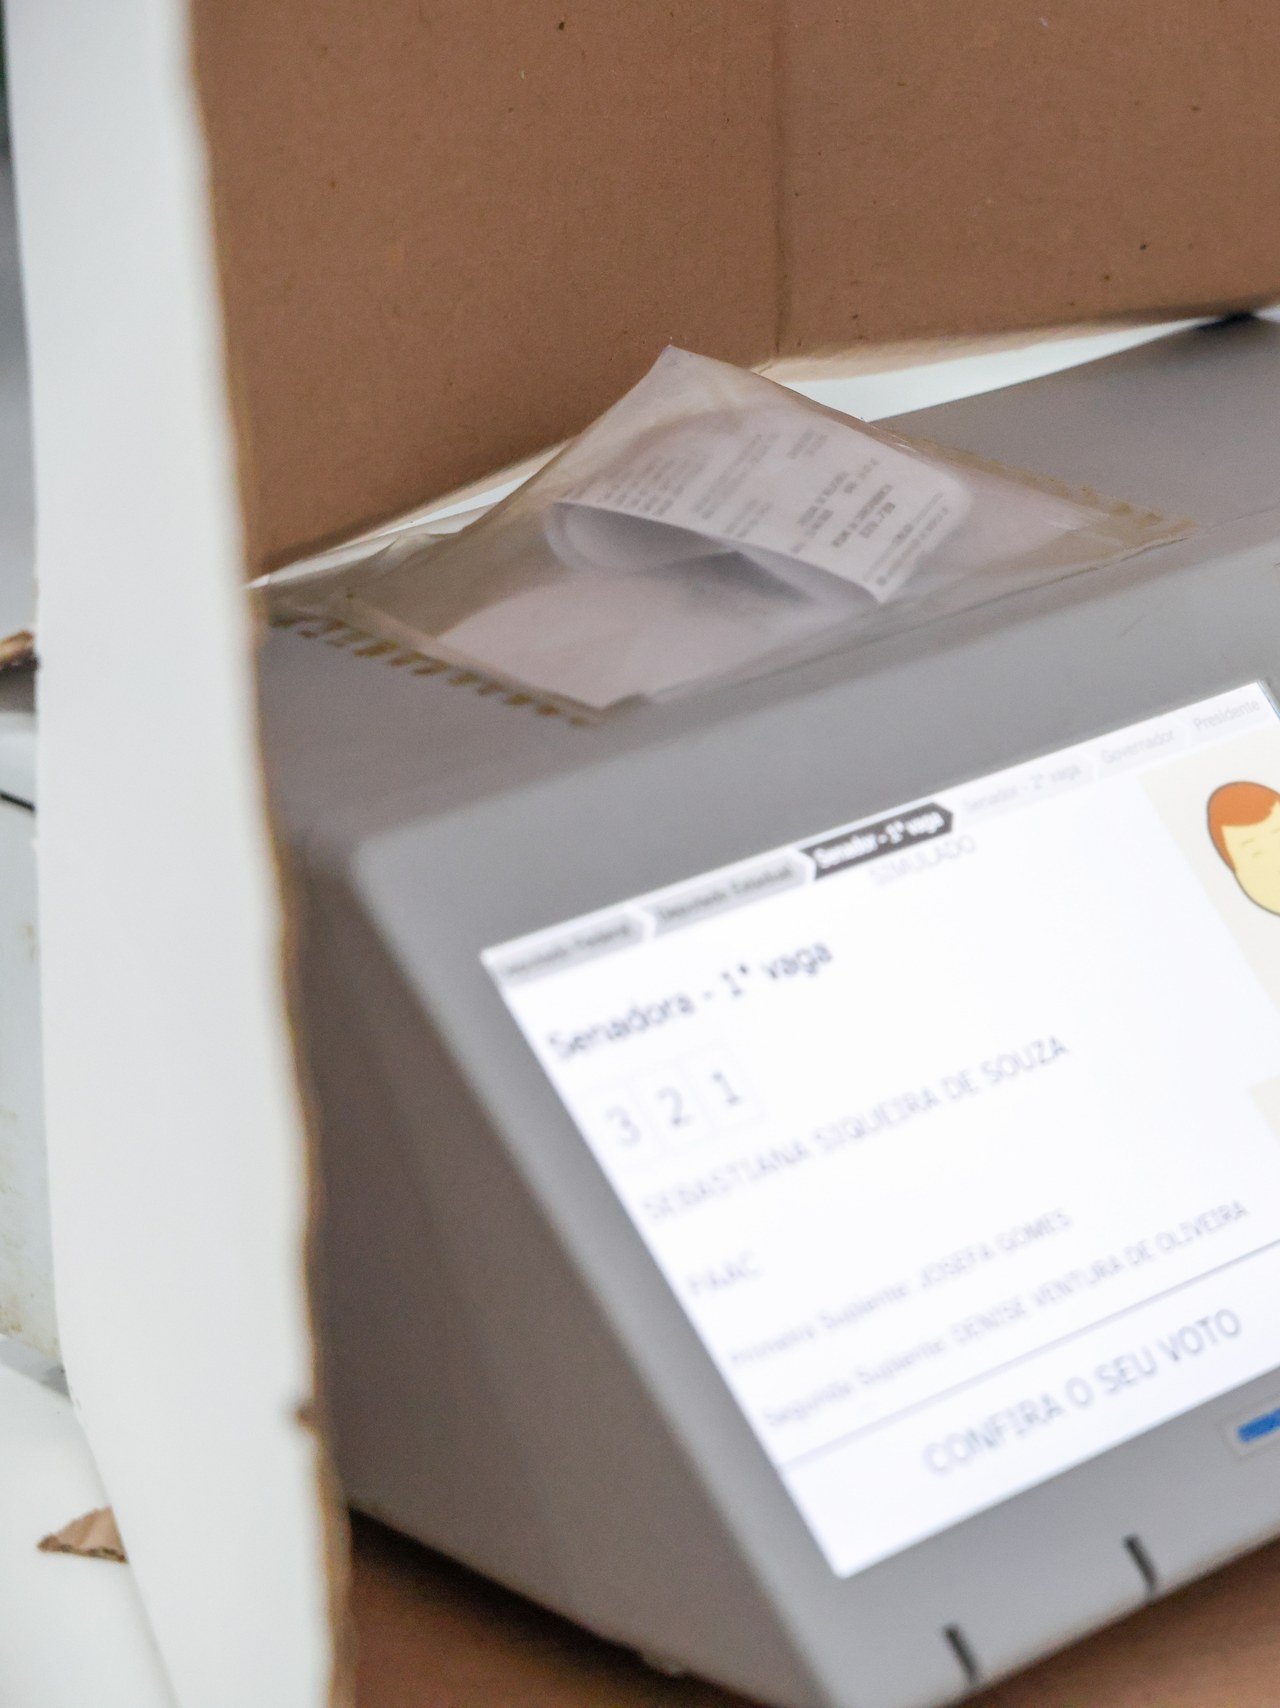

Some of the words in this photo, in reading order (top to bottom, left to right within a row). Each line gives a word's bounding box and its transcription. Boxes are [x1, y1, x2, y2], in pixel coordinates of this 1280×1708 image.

[1100, 728, 1174, 764] Governador
[1192, 698, 1260, 730] Presidente
[813, 830, 878, 871] Senador
[904, 811, 945, 840] vaga
[868, 834, 976, 888] SIMULADO
[548, 991, 695, 1059] Senadora
[766, 940, 833, 983] vaga
[608, 1105, 641, 1147] 3
[657, 1085, 694, 1128] 2
[711, 1068, 741, 1107] 1
[643, 1140, 811, 1222] SEBASTIANA
[812, 1088, 942, 1152] SIQUEIRA
[940, 1070, 980, 1102] DE
[980, 1035, 1069, 1085] SOUZA
[919, 1244, 996, 1289] JOSEFA
[994, 1209, 1072, 1256] GOMES
[953, 1297, 1027, 1346] DENISE
[1033, 1257, 1123, 1309] VENTURA
[1124, 1241, 1155, 1268] DE
[1155, 1202, 1249, 1253] OLIVEIRA
[923, 1391, 1065, 1476] CONFIRA
[1066, 1378, 1094, 1408] O
[1093, 1349, 1158, 1396] SEU
[1161, 1307, 1243, 1363] VOTO
